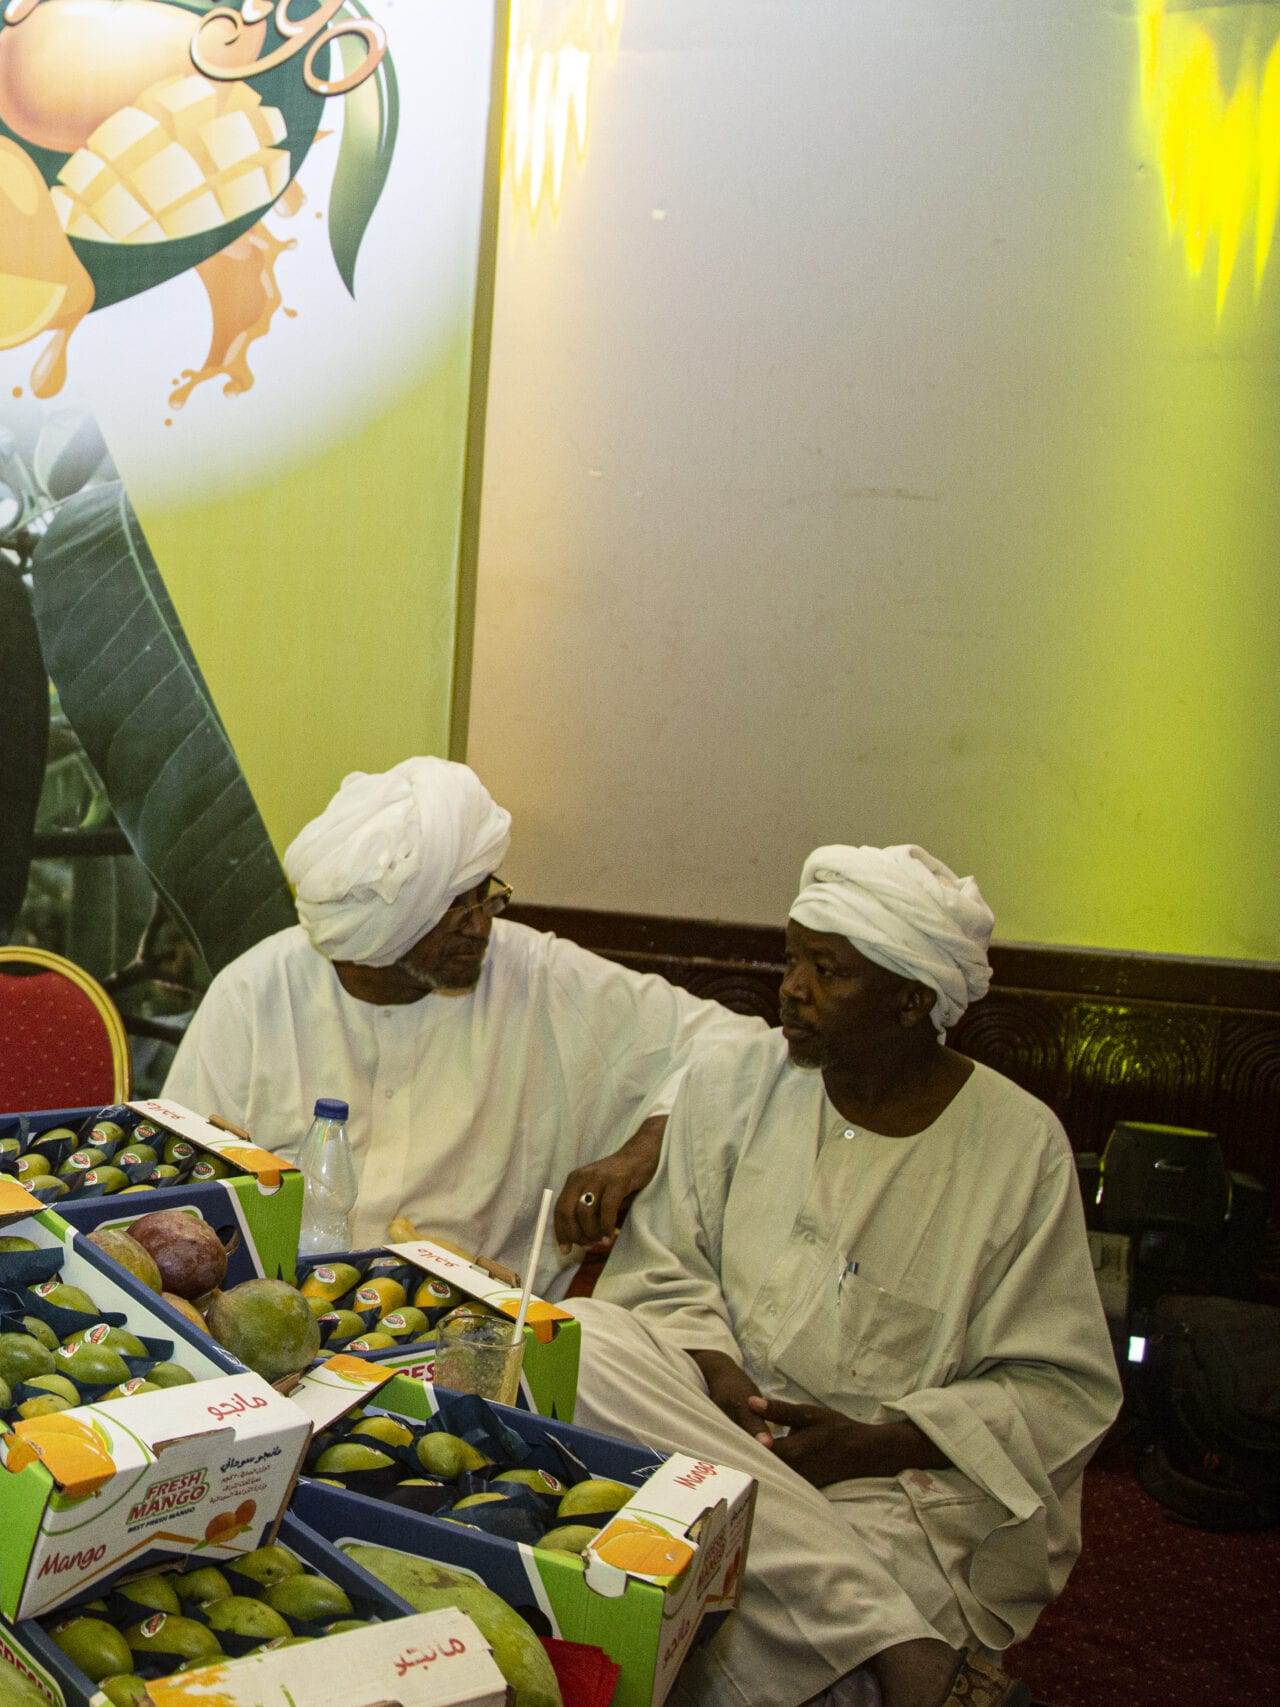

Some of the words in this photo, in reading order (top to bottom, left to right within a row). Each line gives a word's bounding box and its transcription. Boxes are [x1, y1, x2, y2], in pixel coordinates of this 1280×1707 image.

[206, 1392, 268, 1421] مانجو
[146, 1471, 202, 1500] FRESH
[129, 1485, 206, 1521] MANGO
[145, 1515, 168, 1528] FRESH
[167, 1506, 196, 1521] MANGO
[36, 1544, 108, 1580] Mango
